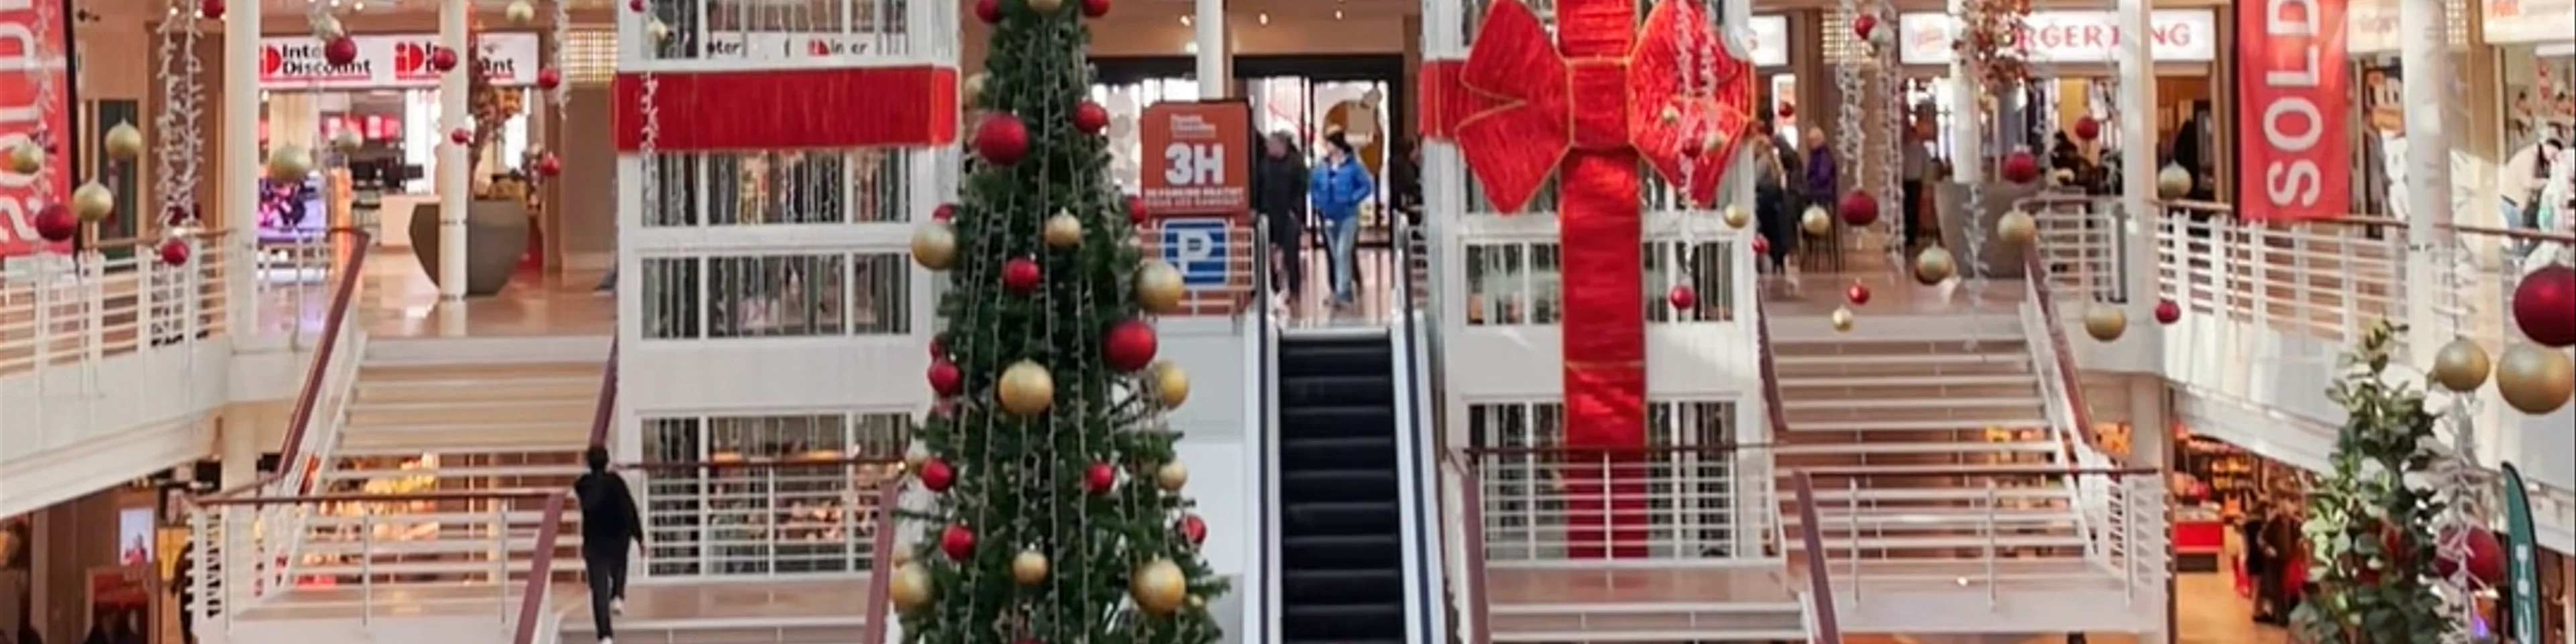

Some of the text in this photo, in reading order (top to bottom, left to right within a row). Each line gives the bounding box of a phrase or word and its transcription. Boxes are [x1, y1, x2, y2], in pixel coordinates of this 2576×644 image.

[2263, 0, 2322, 208] SOLD
[1165, 142, 1224, 185] 3H
[1178, 227, 1213, 276] P
